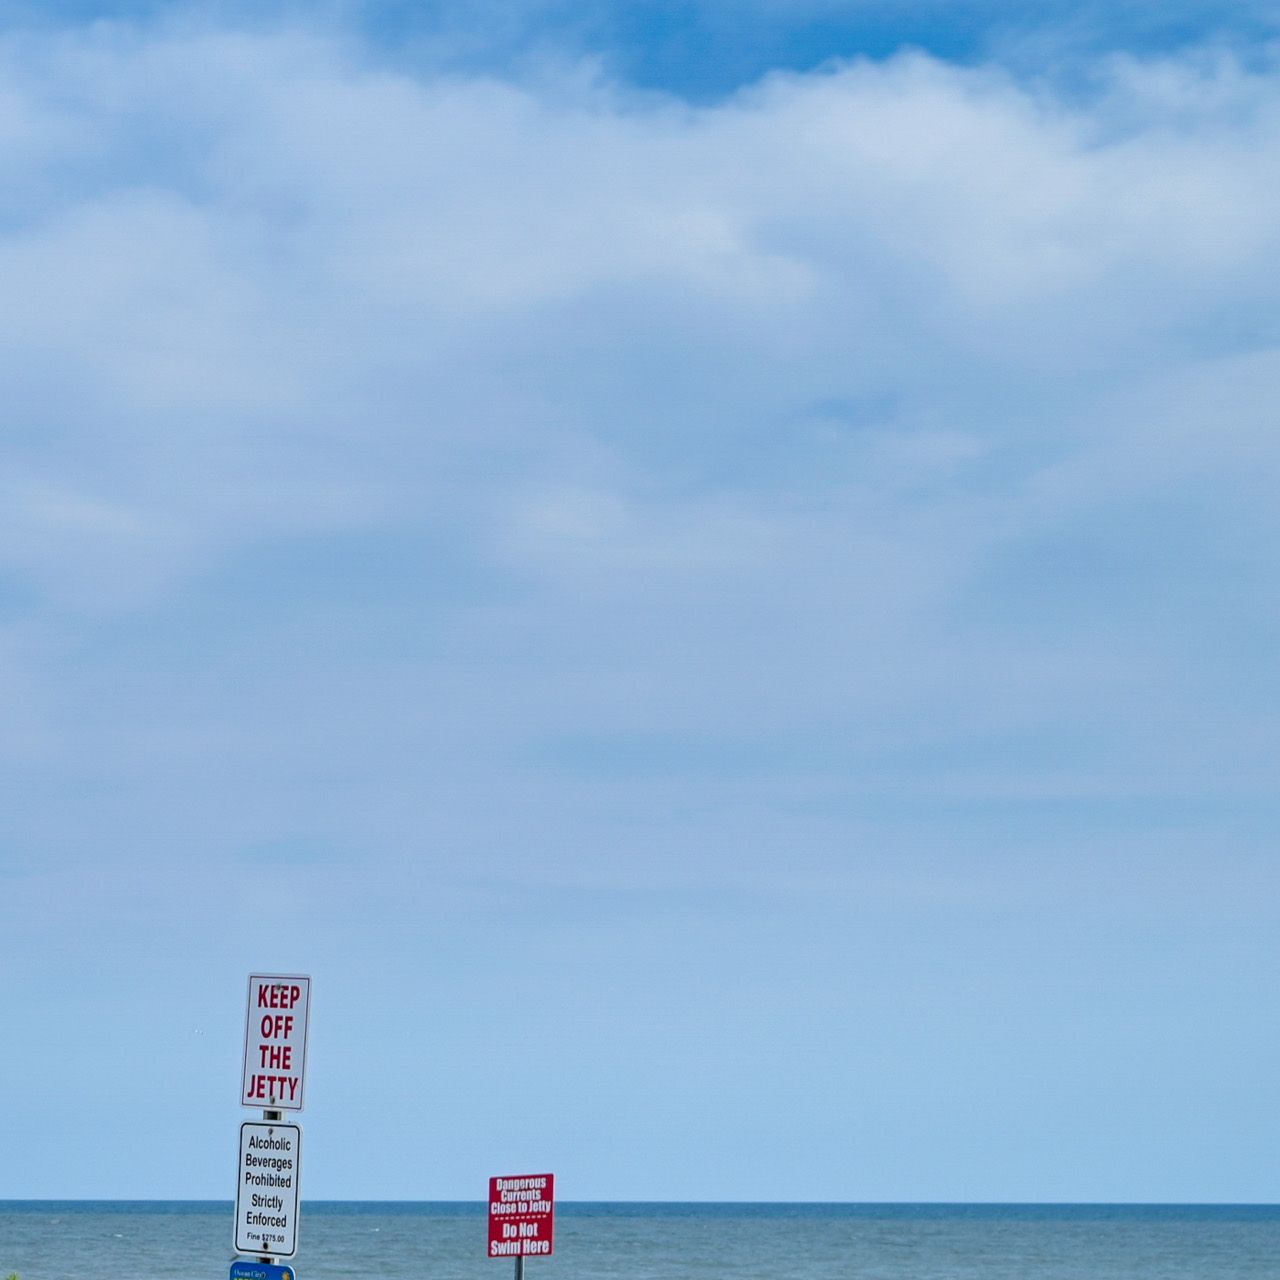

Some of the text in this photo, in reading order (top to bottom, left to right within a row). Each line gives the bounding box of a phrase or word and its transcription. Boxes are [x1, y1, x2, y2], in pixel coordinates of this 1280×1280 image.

[258, 984, 300, 1009] KEEP
[260, 1016, 293, 1039] OFF
[260, 1046, 291, 1069] THE
[248, 1074, 298, 1100] JETTY
[249, 1136, 291, 1151] Alcoholic
[246, 1154, 292, 1171] Beverages
[245, 1172, 292, 1188] Prohibited
[496, 1178, 546, 1191] Dangerous
[252, 1194, 283, 1212] Strictly
[501, 1189, 541, 1202] Currents
[491, 1201, 551, 1214] Close to Jetty
[246, 1212, 286, 1228] Enforced
[247, 1232, 284, 1243] Fine $275.00
[502, 1222, 538, 1238] Do Not
[491, 1240, 549, 1255] Swim Here
